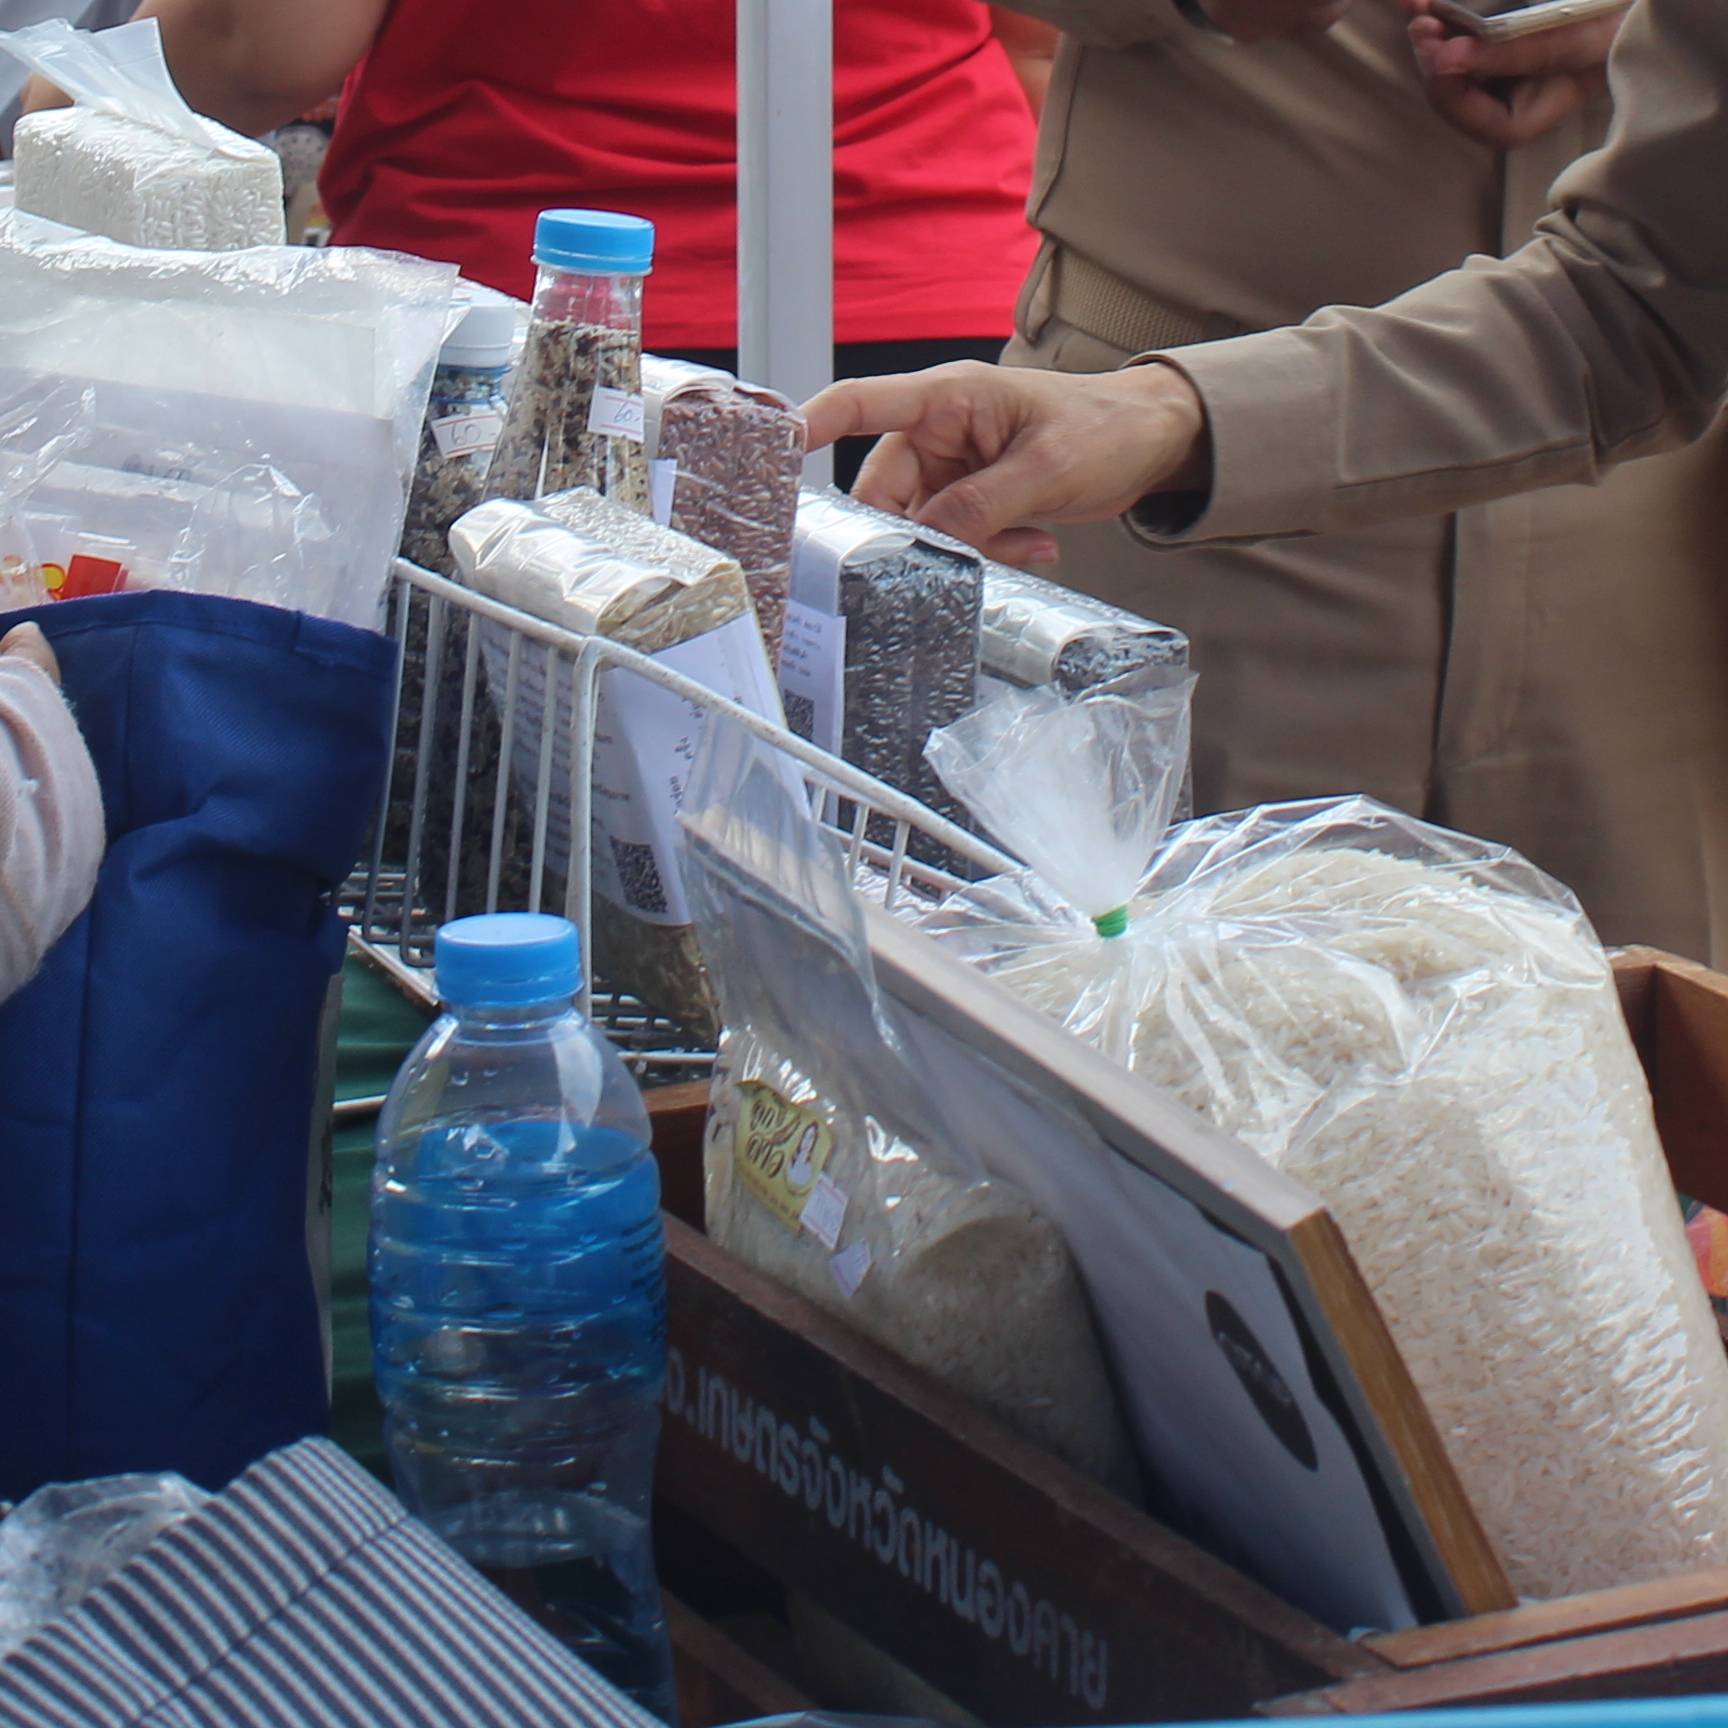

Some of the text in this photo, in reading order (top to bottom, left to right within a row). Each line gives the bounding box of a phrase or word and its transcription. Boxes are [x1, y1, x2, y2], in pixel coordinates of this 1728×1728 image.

[665, 1345, 1109, 1712] ง.เกษตรจังหวัดหนองคาย
